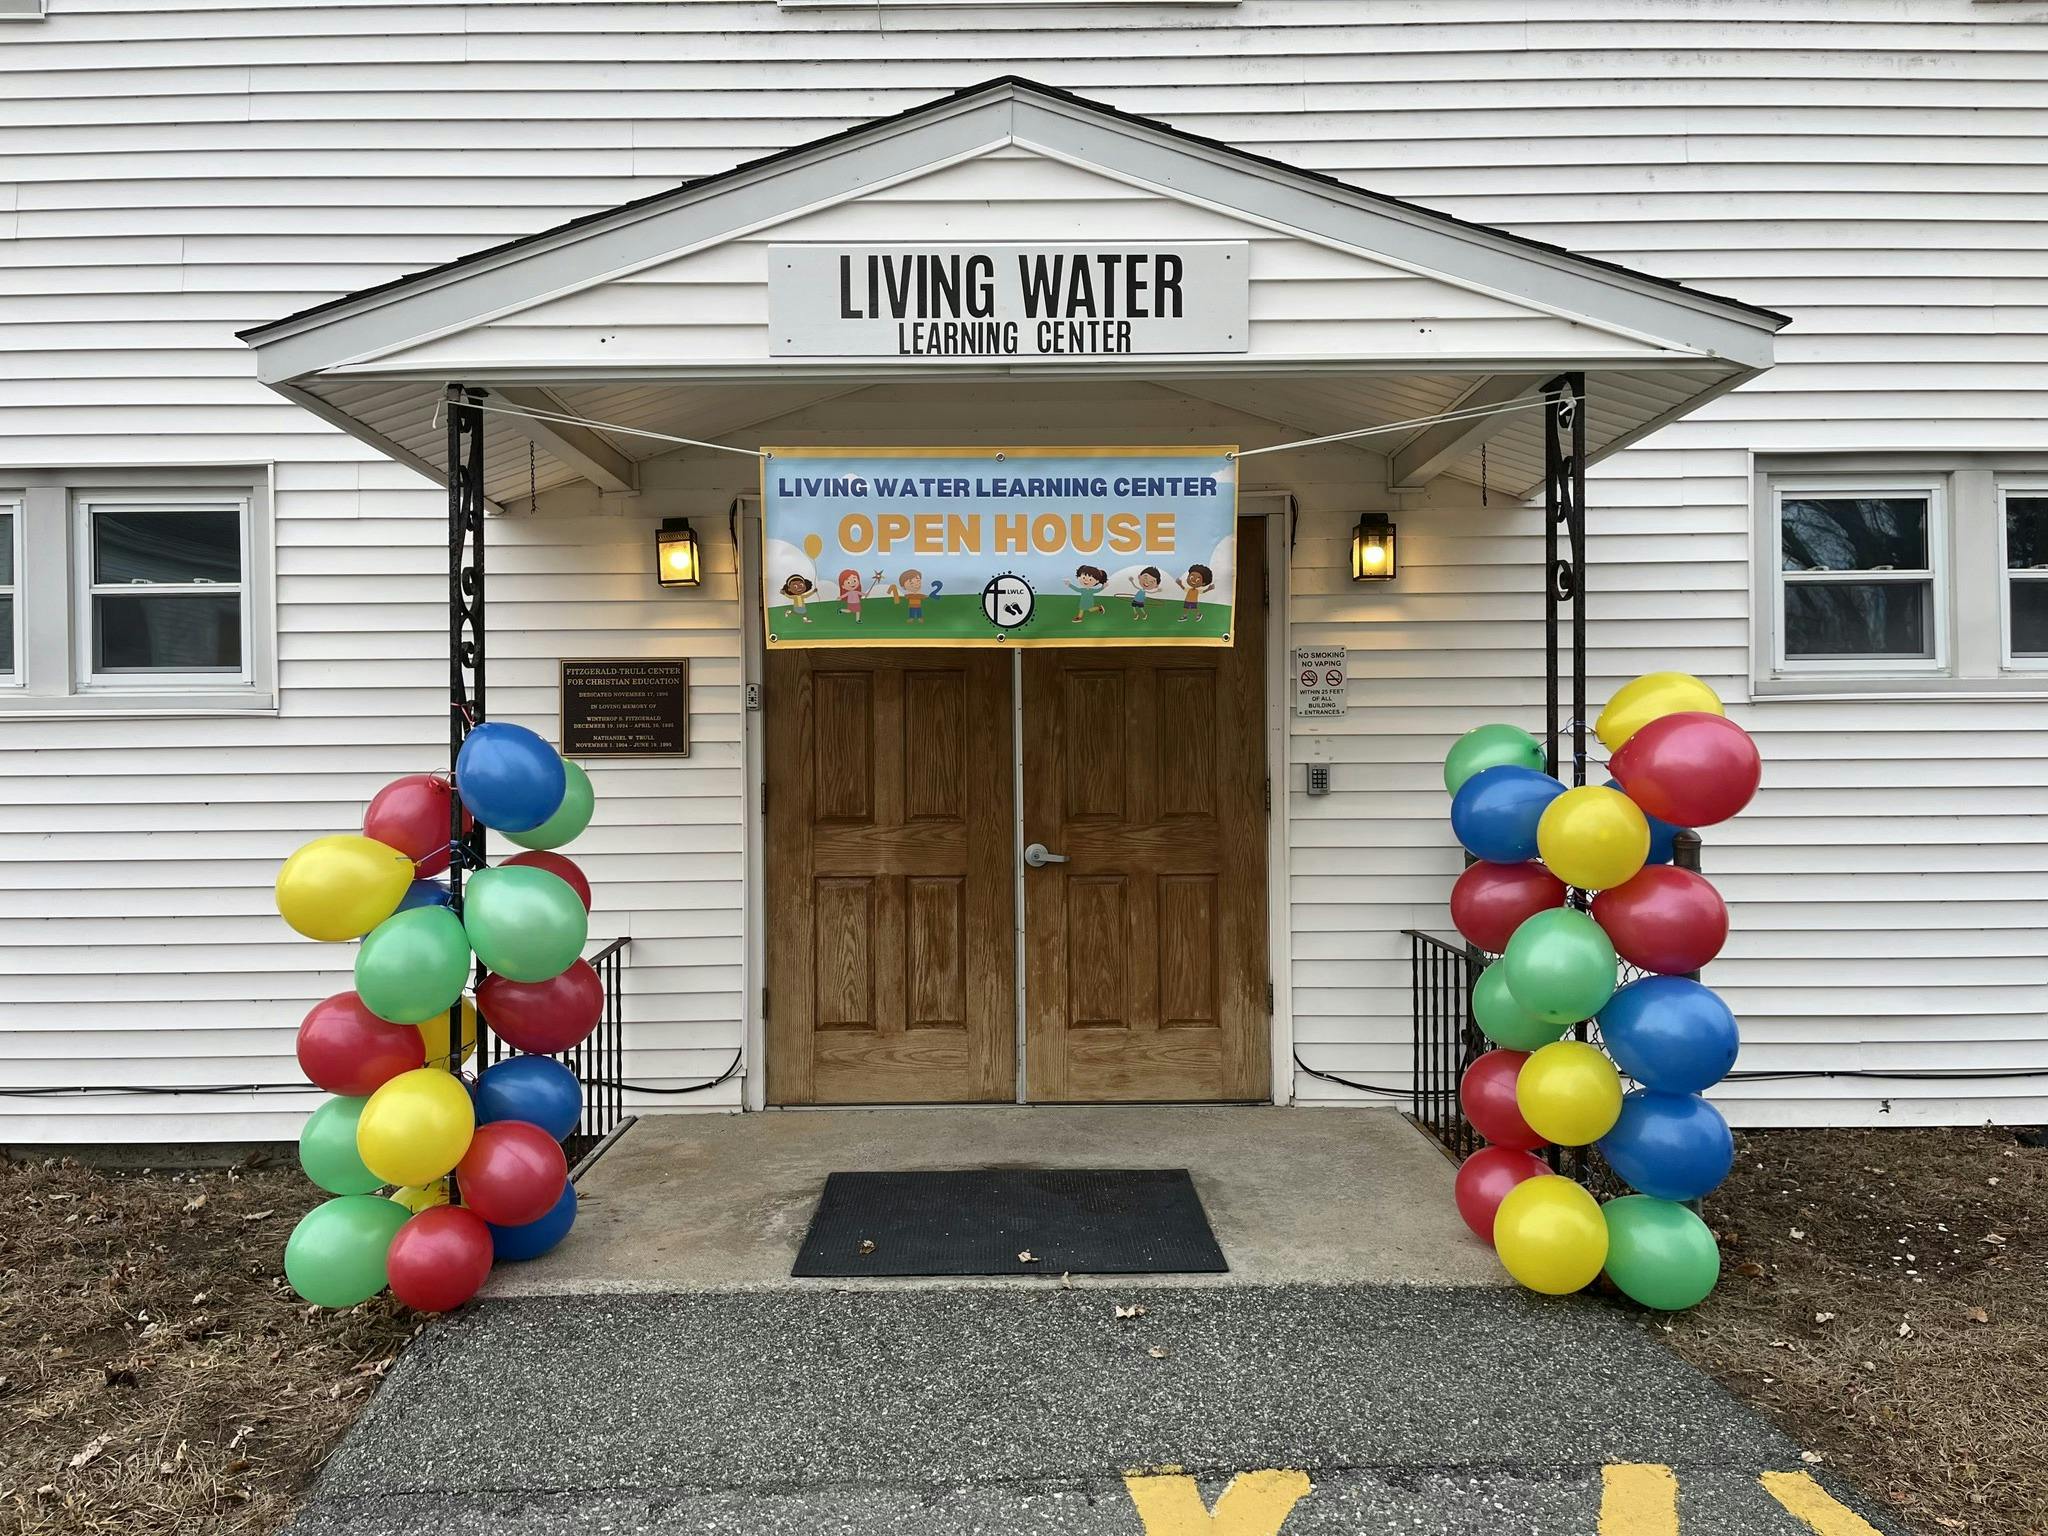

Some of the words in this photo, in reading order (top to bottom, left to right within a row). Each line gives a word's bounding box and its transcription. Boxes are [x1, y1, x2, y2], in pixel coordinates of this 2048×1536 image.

[840, 254, 995, 319] LIVING
[1018, 253, 1184, 319] WATER
[899, 320, 1018, 355] LEARNING
[1037, 320, 1131, 353] CENTER
[778, 477, 869, 498] LIVING
[874, 477, 971, 498] WATER
[976, 477, 1108, 498] LEARNING
[1112, 476, 1217, 497] CENTER
[837, 512, 981, 555] OPEN
[994, 512, 1176, 555] HOUSE
[929, 580, 943, 600] 2
